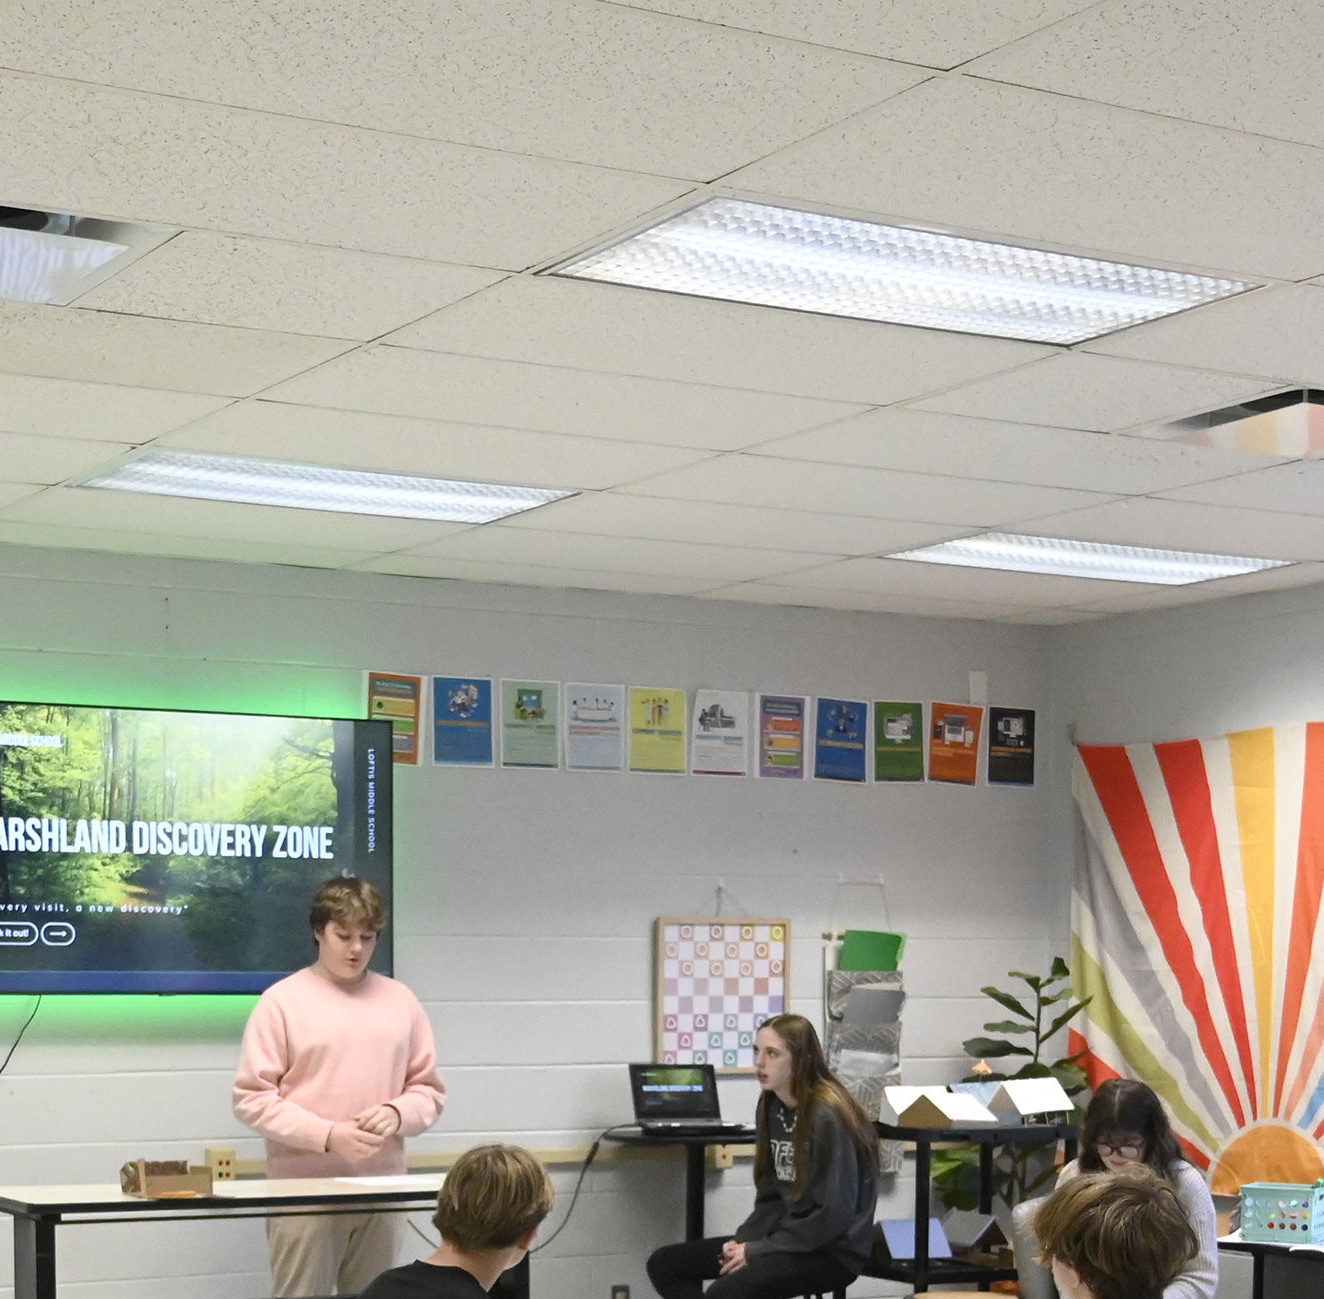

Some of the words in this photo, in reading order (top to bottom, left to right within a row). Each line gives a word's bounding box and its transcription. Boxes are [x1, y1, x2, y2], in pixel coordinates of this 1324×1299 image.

[30, 736, 63, 748] SCHOOL
[368, 748, 376, 779] LOFTIS
[368, 782, 376, 814] MIDDLE
[132, 820, 267, 857] DISCOVERY
[273, 825, 335, 860] ZONE
[368, 818, 376, 854] SCHOOL
[34, 903, 70, 913] visit,
[76, 904, 83, 913] a
[89, 905, 114, 913] new
[5, 929, 12, 938] it
[12, 929, 30, 938] out!
